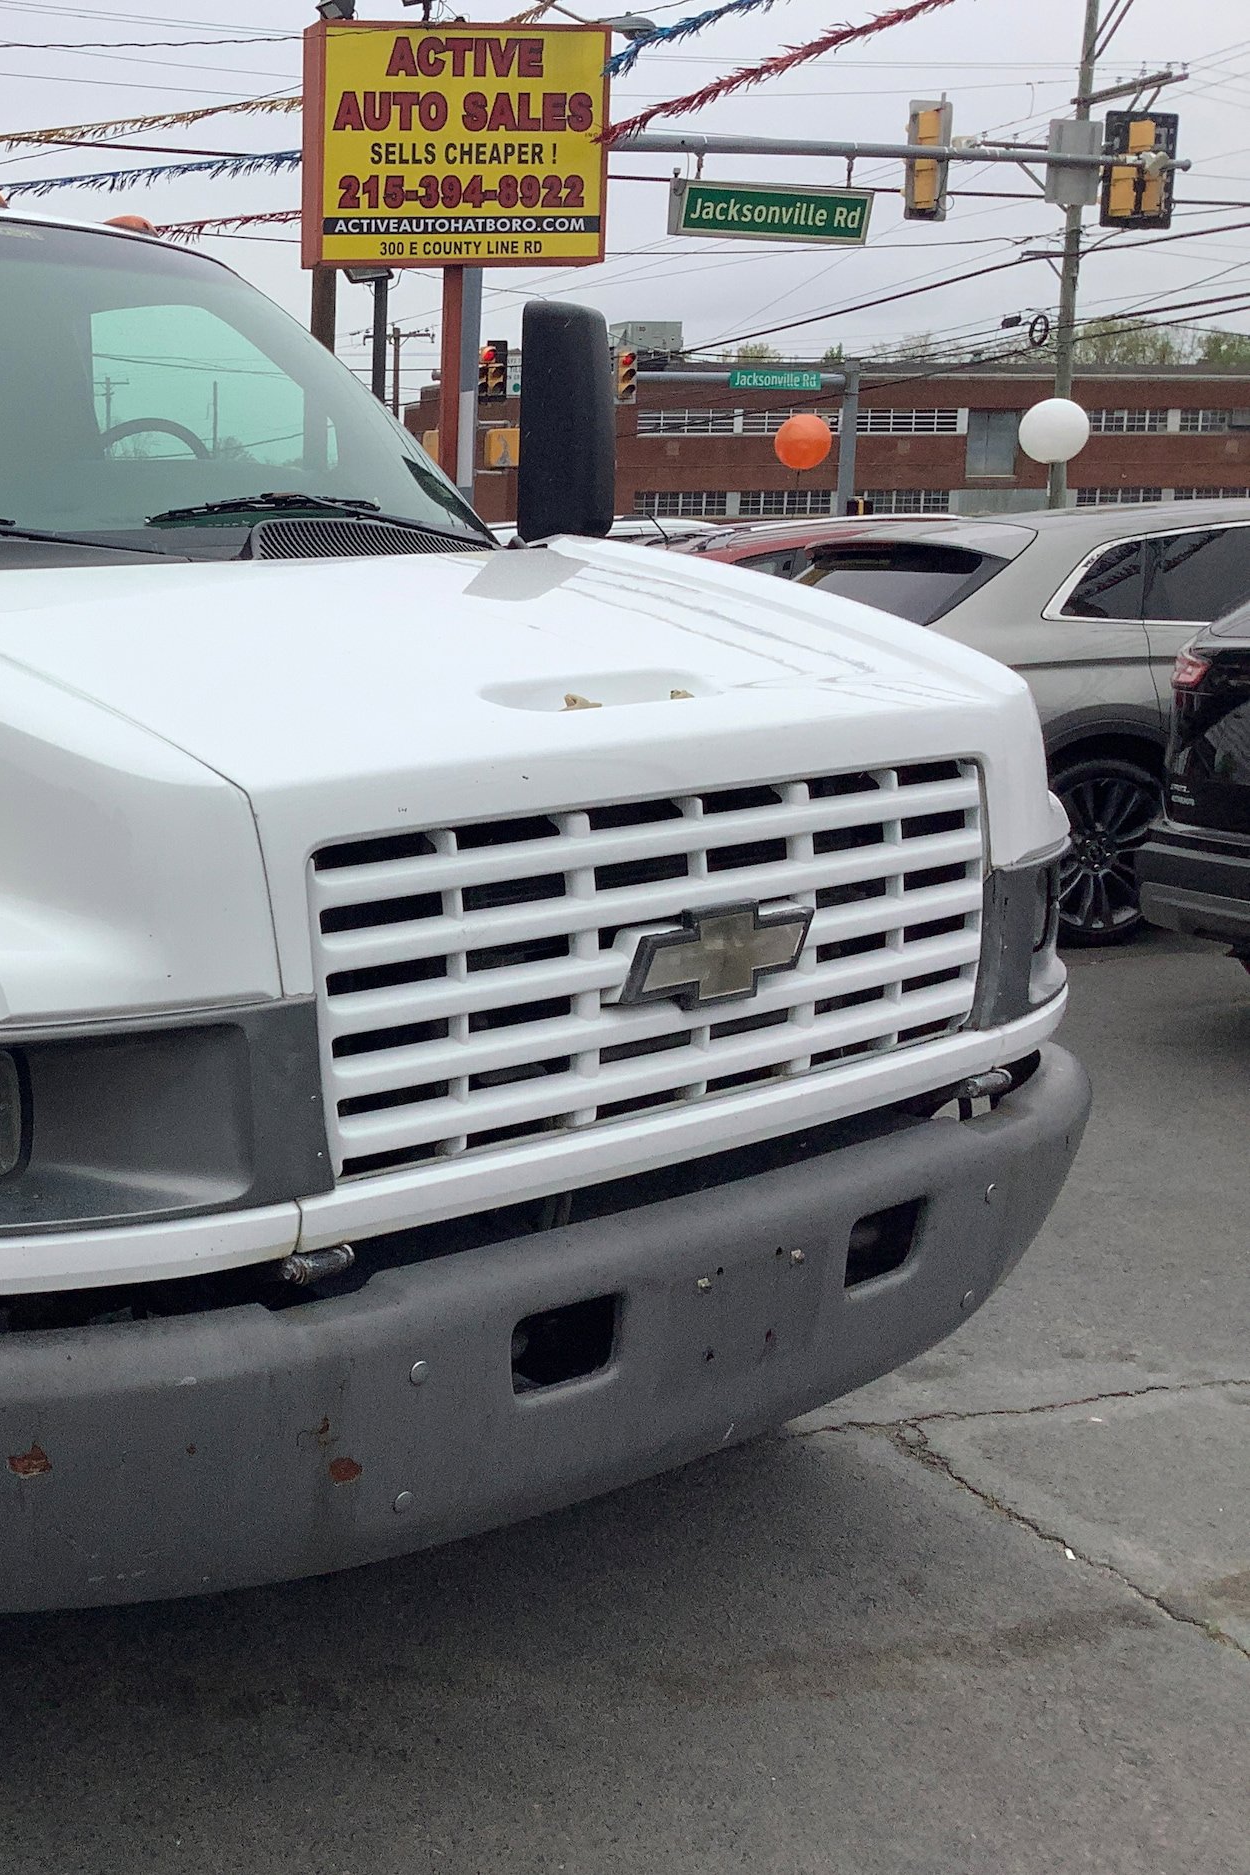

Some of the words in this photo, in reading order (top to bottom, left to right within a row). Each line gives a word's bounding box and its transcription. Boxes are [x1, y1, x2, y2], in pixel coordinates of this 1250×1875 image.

[386, 37, 544, 77] ACTIVE
[333, 91, 448, 131] AUTO
[461, 92, 594, 132] SALES
[370, 143, 437, 165] SELLS
[444, 143, 544, 165] CHEAPER
[337, 175, 585, 209] 215-394-8922
[334, 218, 585, 234] ACTIVEAUTOHATBORO.COM
[690, 197, 829, 227] Jacksonville
[833, 206, 862, 229] Rd
[380, 242, 404, 255] 300
[409, 242, 418, 255] E
[423, 241, 481, 255] COUNTY
[487, 241, 519, 254] LINE
[524, 240, 543, 254] RD
[735, 372, 800, 386] Jacksonville
[802, 373, 817, 387] Rd
